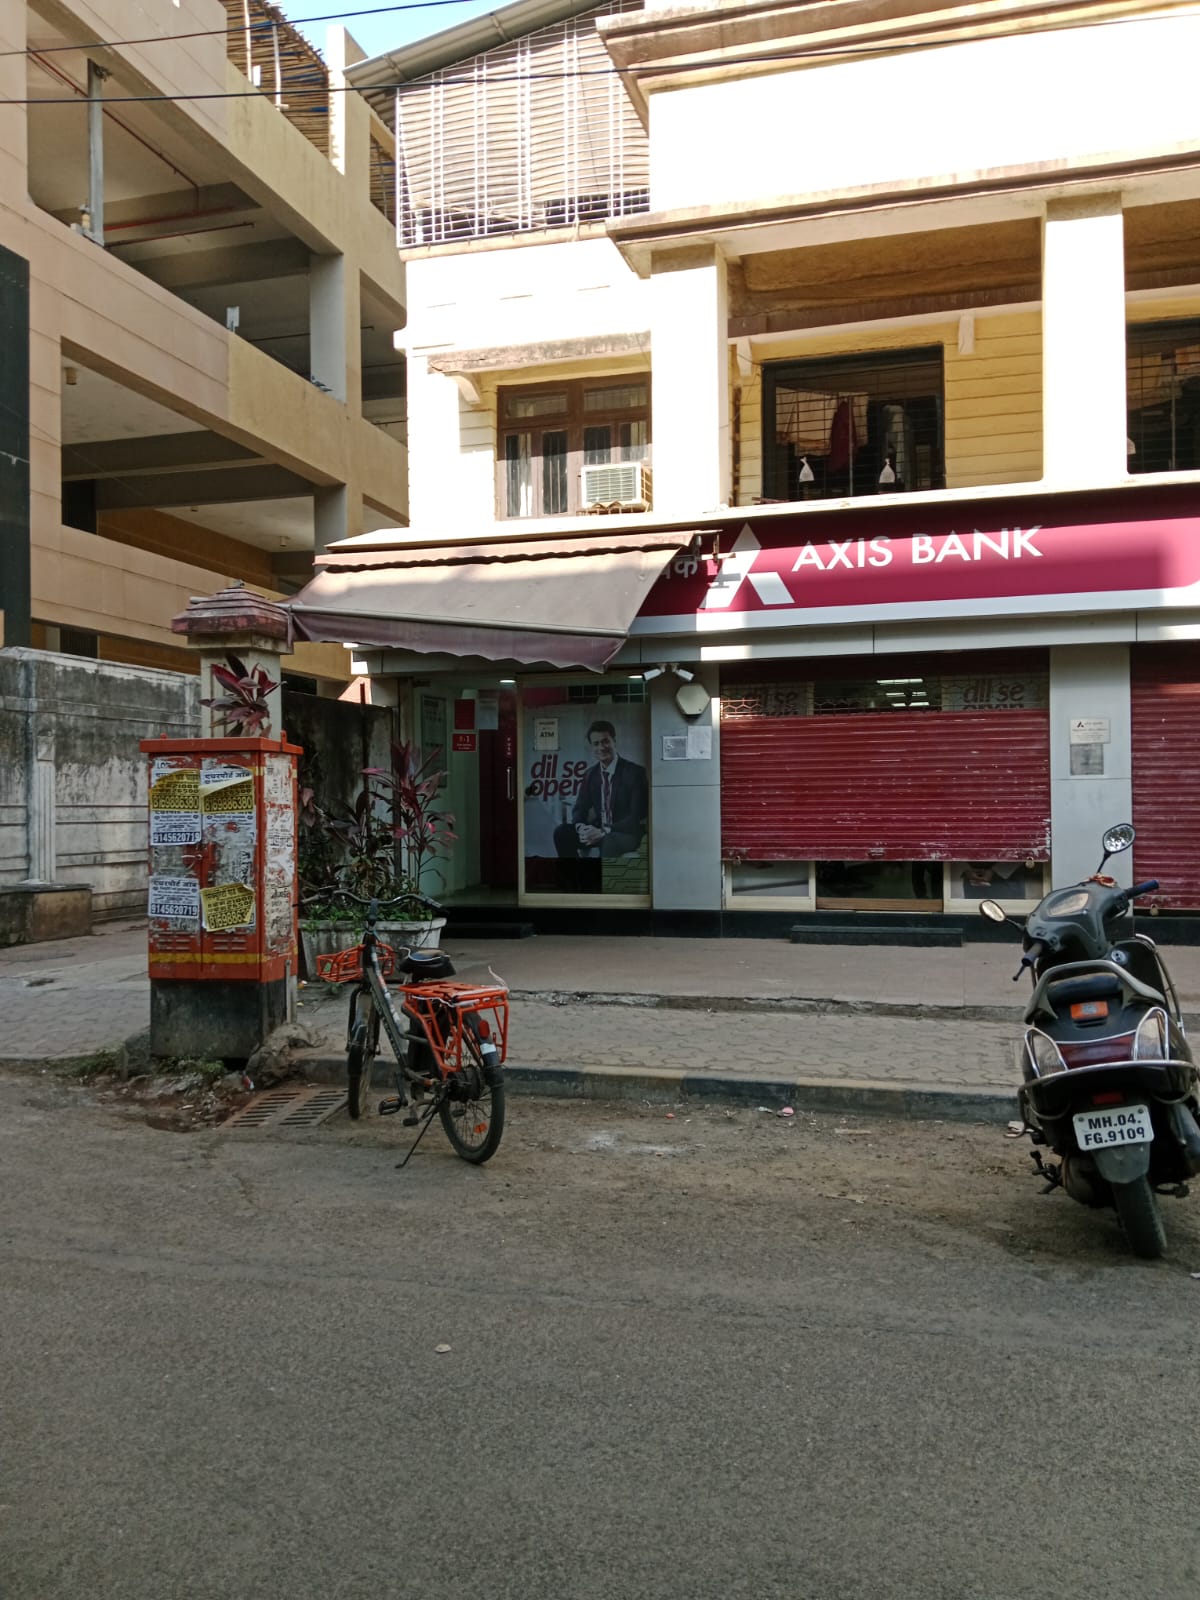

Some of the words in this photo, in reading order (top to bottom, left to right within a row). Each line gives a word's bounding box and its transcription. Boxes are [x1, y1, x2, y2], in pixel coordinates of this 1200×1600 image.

[792, 534, 893, 572] AXIS
[911, 525, 1043, 565] BANK
[996, 682, 1024, 702] se
[530, 754, 560, 779] dil
[562, 759, 588, 777] se
[153, 796, 199, 808] 8169886380
[205, 796, 252, 811] 8169886380
[153, 832, 200, 842] 9145620719
[151, 904, 197, 916] 9145620719
[1084, 1126, 1145, 1146] FG.9109
